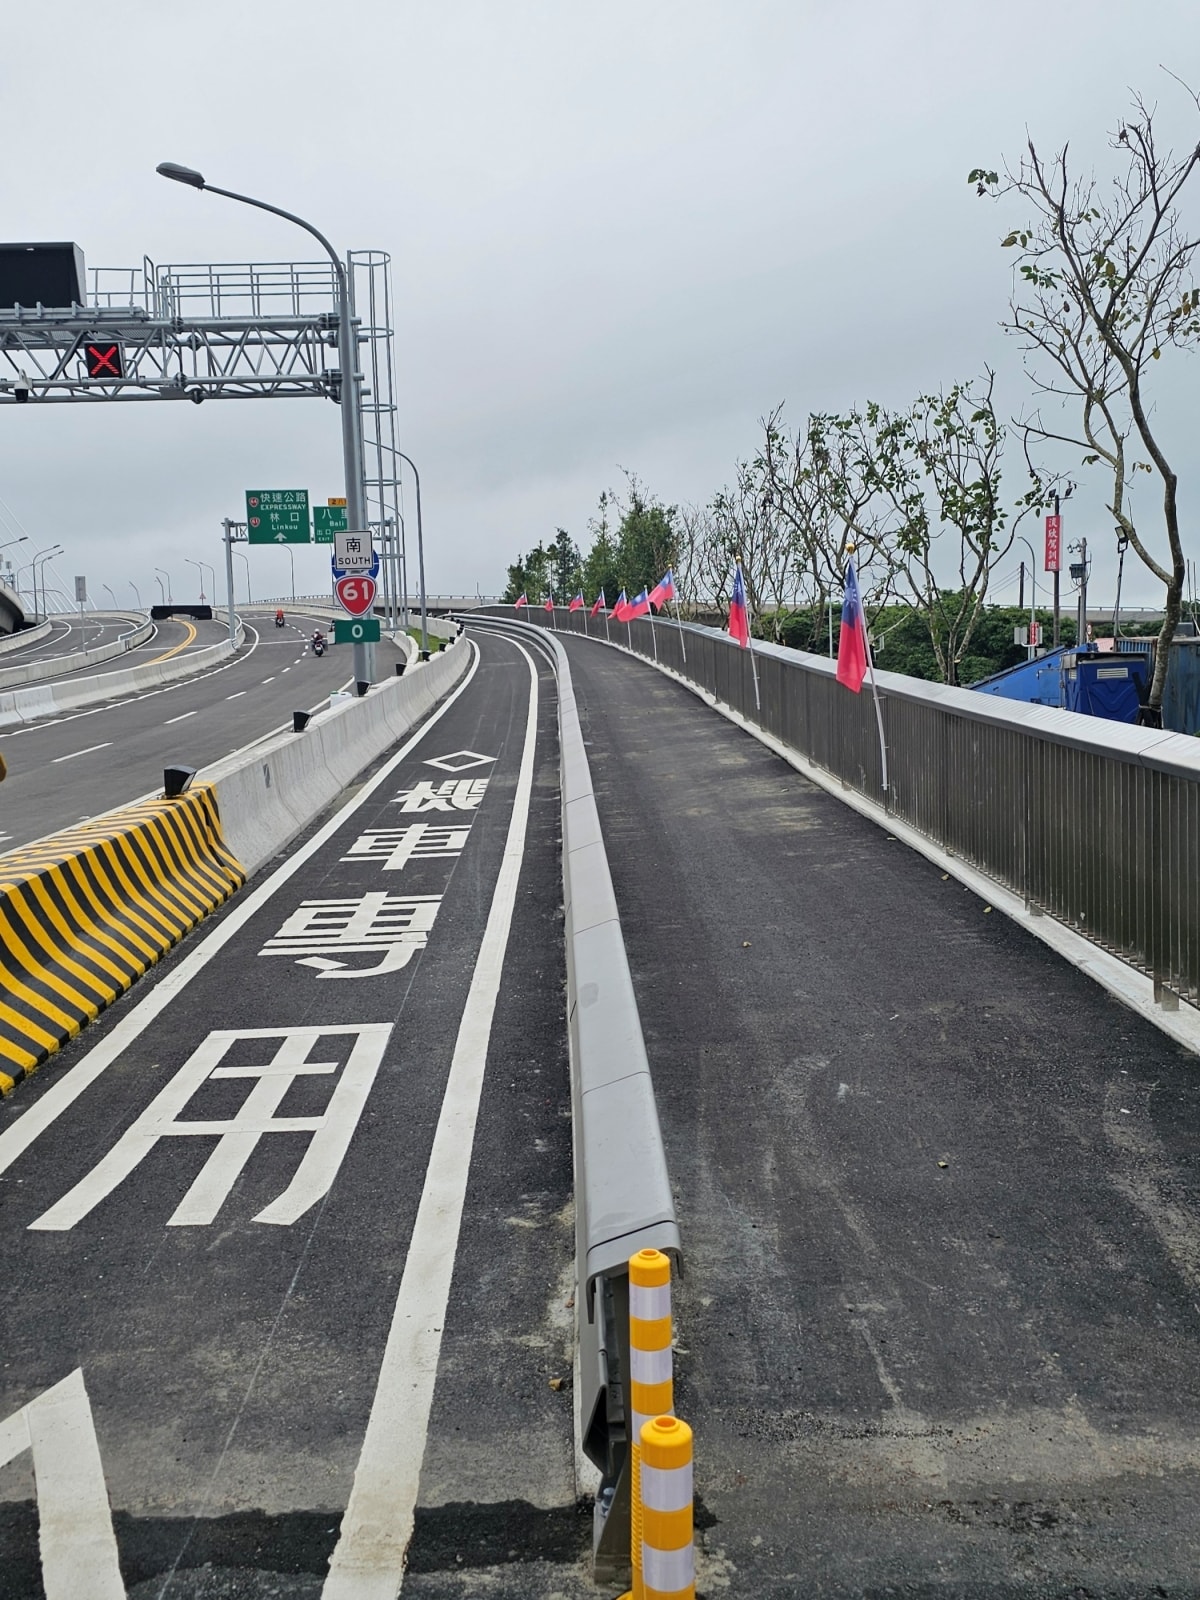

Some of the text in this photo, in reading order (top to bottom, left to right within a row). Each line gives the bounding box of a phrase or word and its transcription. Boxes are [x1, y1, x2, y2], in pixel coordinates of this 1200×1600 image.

[260, 492, 306, 502] 快速公路
[270, 512, 299, 522] 林口
[345, 537, 361, 553] 南
[338, 557, 370, 565] SOUTH
[342, 581, 369, 601] 61
[351, 624, 363, 638] 0
